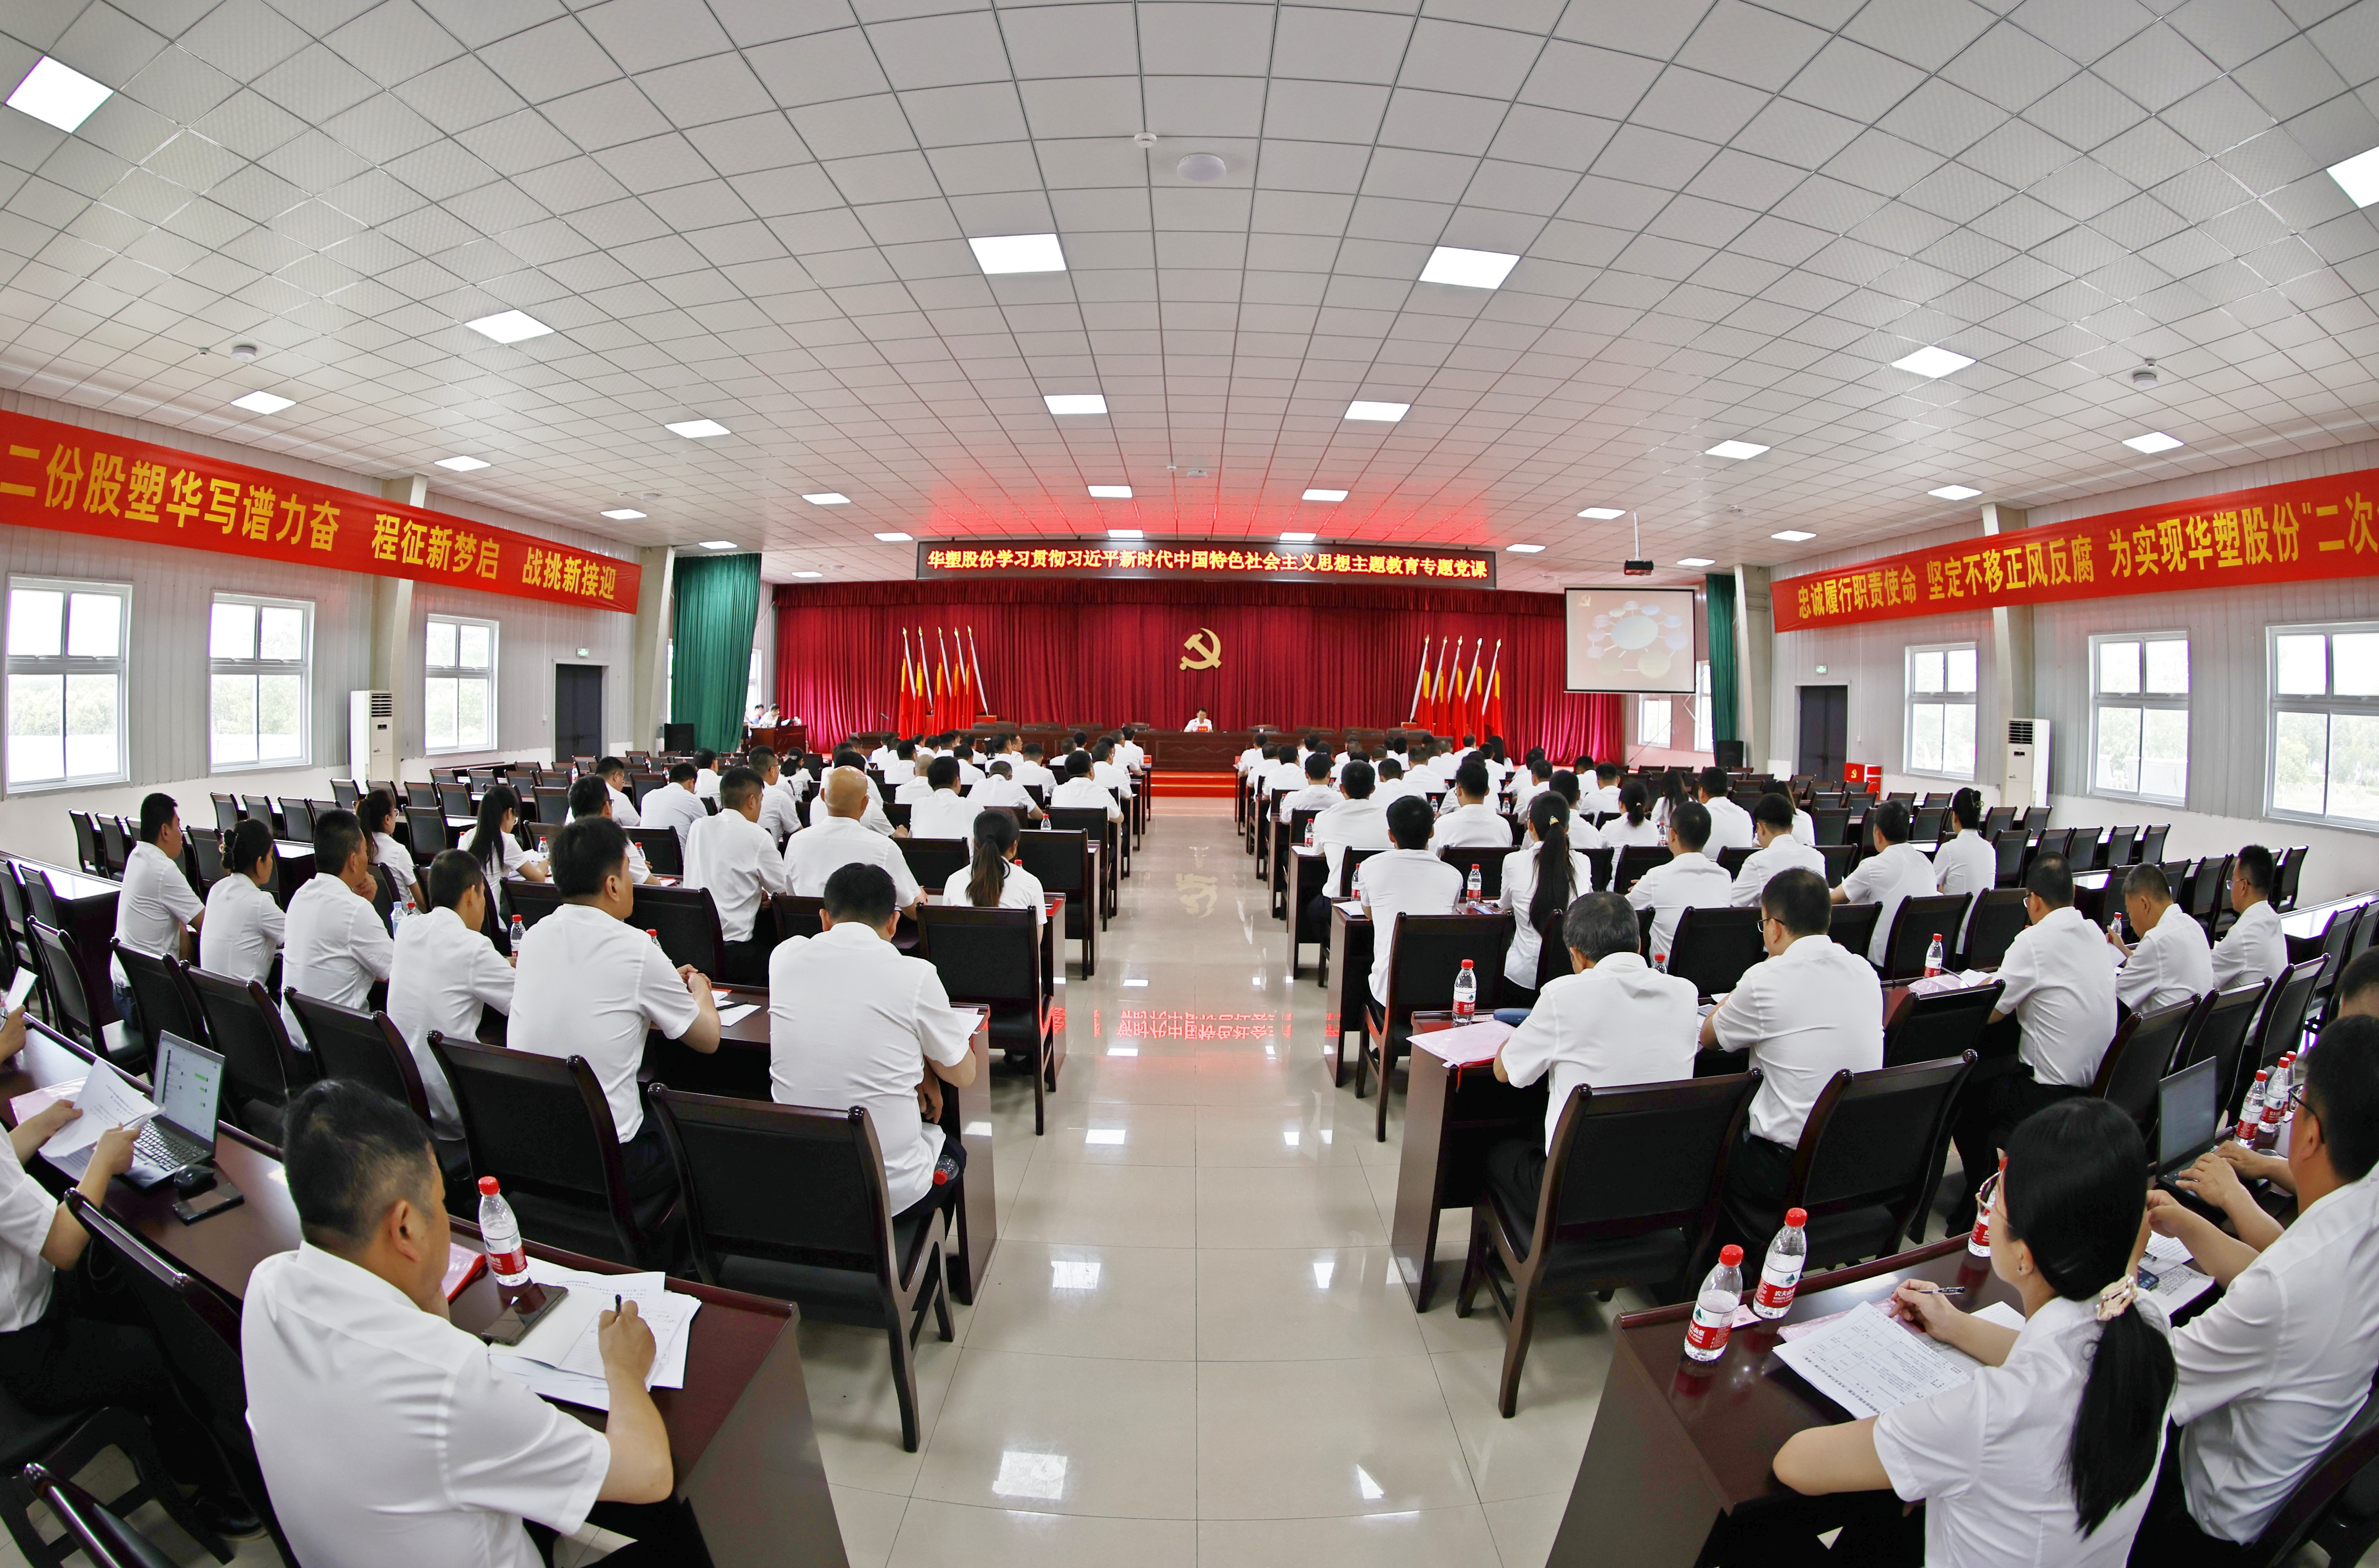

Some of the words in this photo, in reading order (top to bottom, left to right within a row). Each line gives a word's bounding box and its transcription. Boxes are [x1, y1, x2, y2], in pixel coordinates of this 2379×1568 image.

[926, 548, 1488, 579] 华塑股份学习贯彻习近平新时代中国特色社会主义思想主题教育专题党课
[1798, 563, 1917, 619] 忠诚履行职责使命
[1926, 533, 2095, 601] 坚定不移正风反腐
[2108, 491, 2379, 578] 为实现华塑股份"二次
